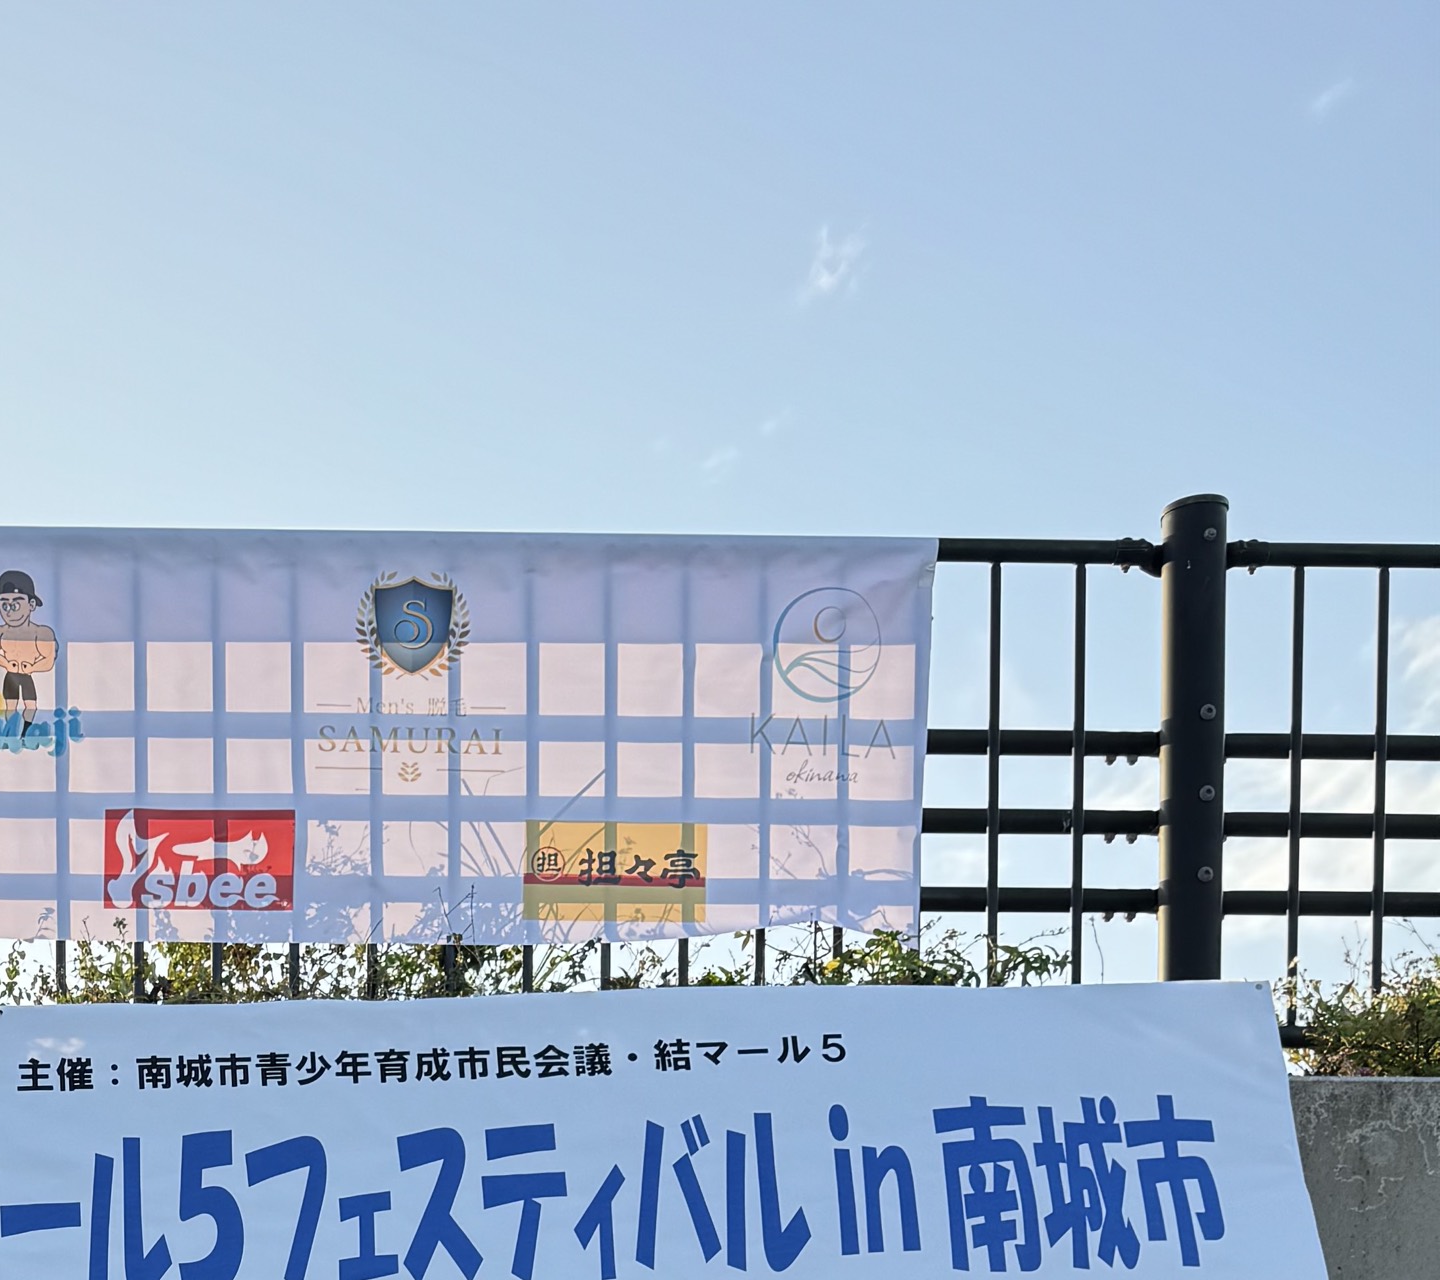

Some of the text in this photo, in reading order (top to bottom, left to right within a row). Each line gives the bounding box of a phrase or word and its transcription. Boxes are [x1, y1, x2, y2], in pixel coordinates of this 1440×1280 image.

[356, 697, 414, 715] Men's
[318, 725, 503, 756] SAMURAI
[750, 712, 896, 759] KAILA
[786, 760, 859, 784] okinawa
[829, 1104, 921, 1256] in
[933, 1095, 1225, 1272] 南城市
